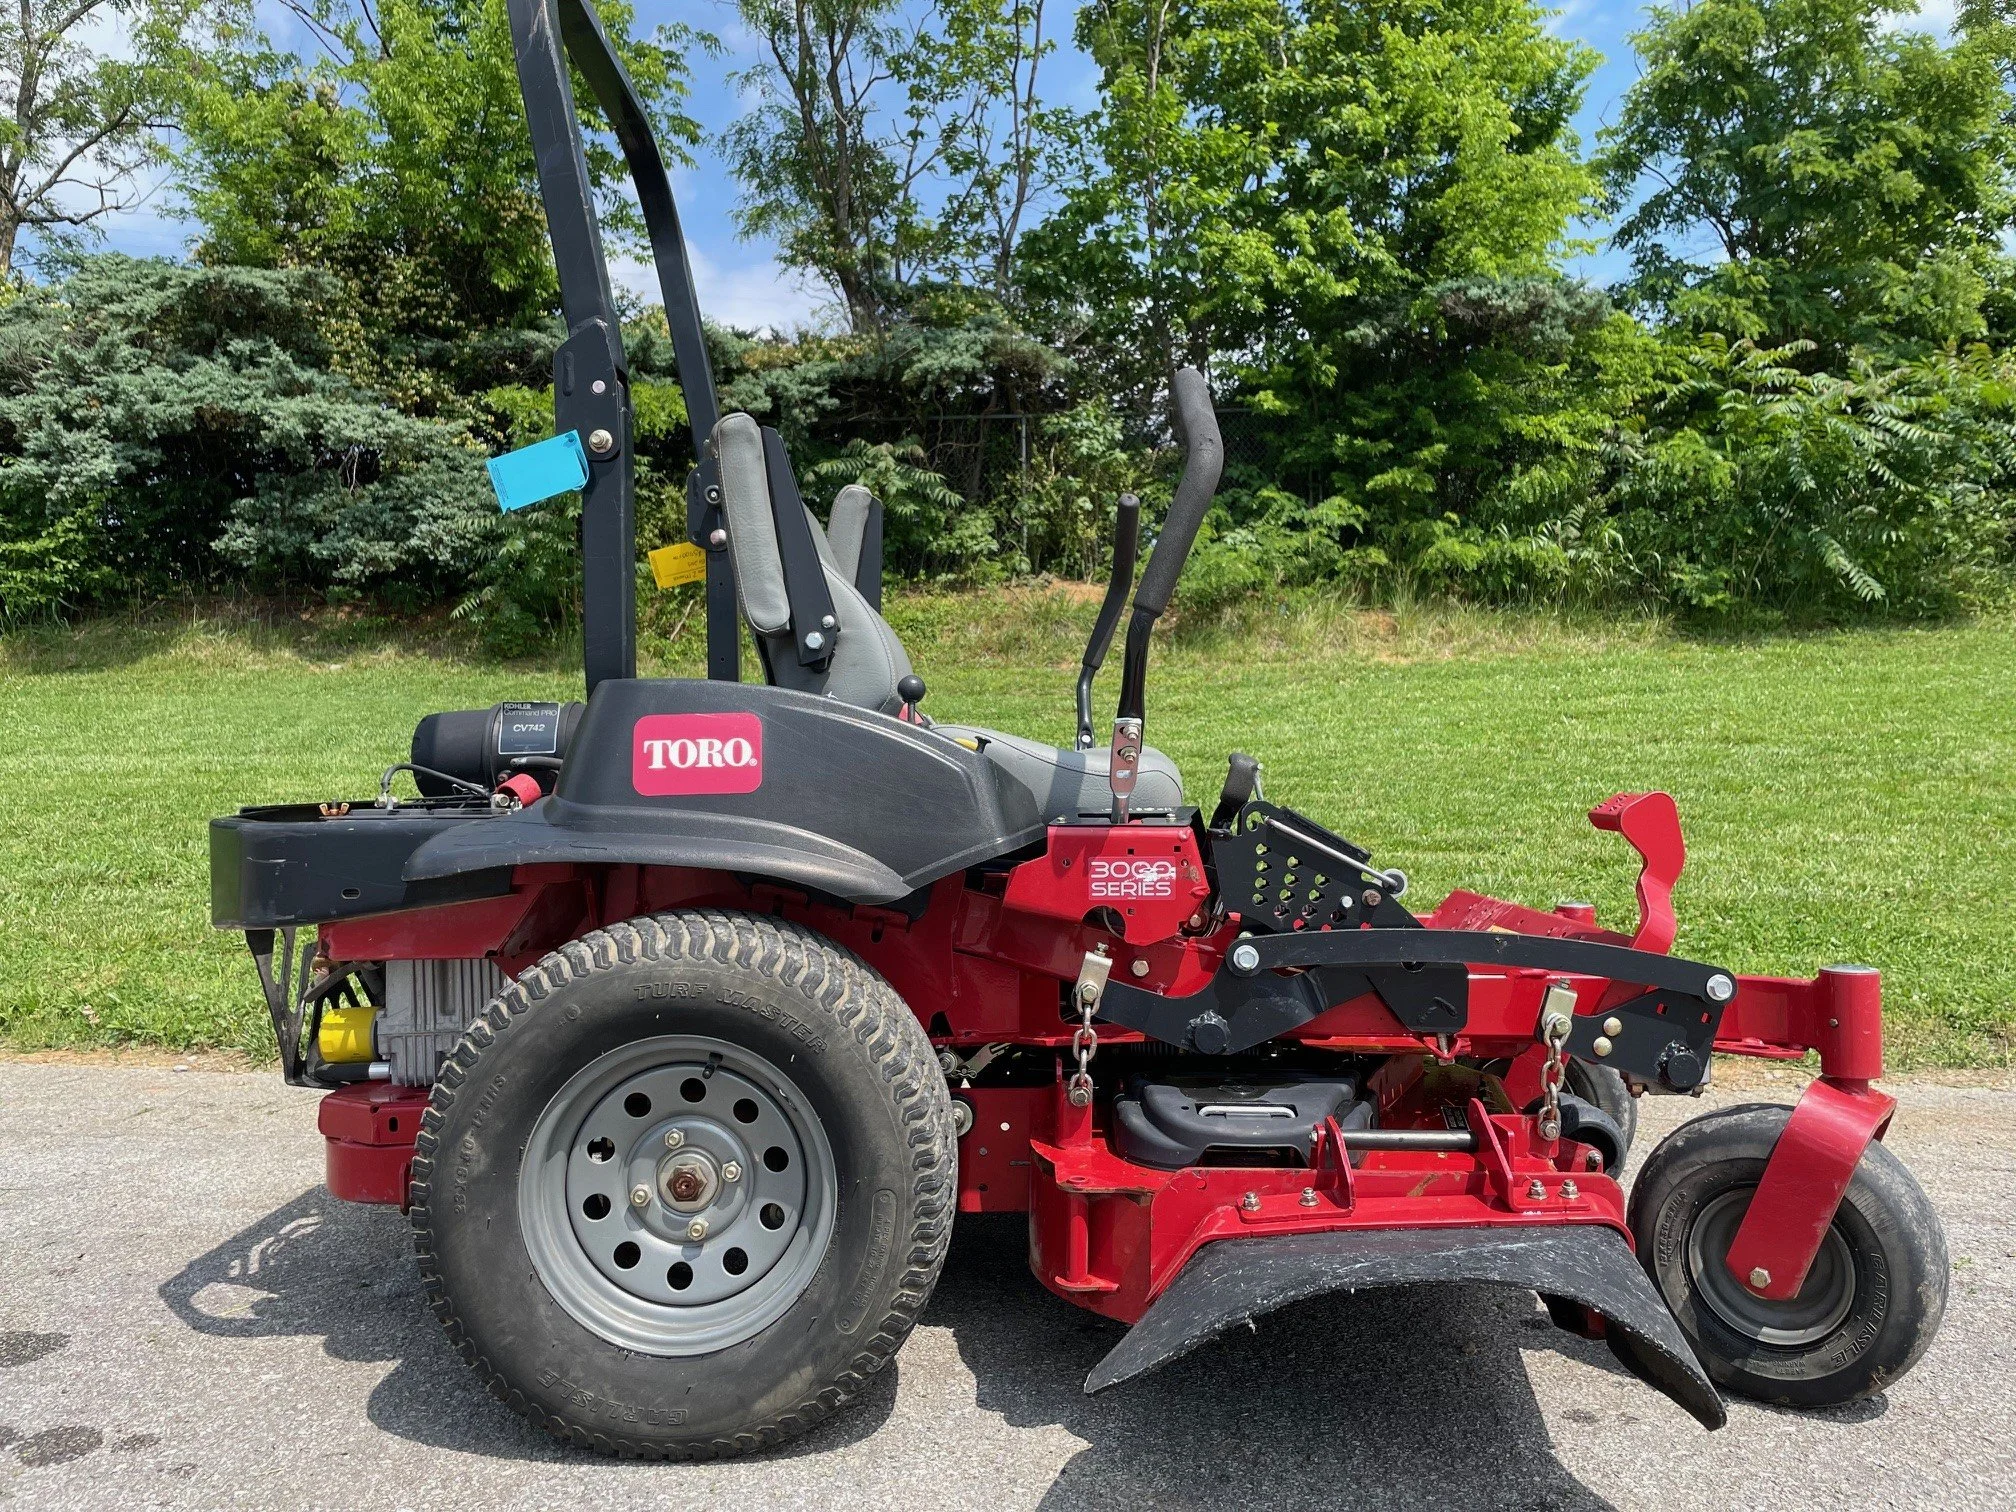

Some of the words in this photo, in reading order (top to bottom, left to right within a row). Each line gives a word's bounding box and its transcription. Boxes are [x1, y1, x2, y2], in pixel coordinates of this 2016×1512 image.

[513, 724, 546, 732] CV742
[540, 709, 558, 717] PRO
[643, 737, 753, 769] TORO
[1091, 881, 1172, 896] SERIES
[632, 981, 710, 1001] TURF
[716, 986, 829, 1055] MASTER
[1830, 1252, 1888, 1369] CARLISLE
[536, 1367, 690, 1426] CARLISLE
